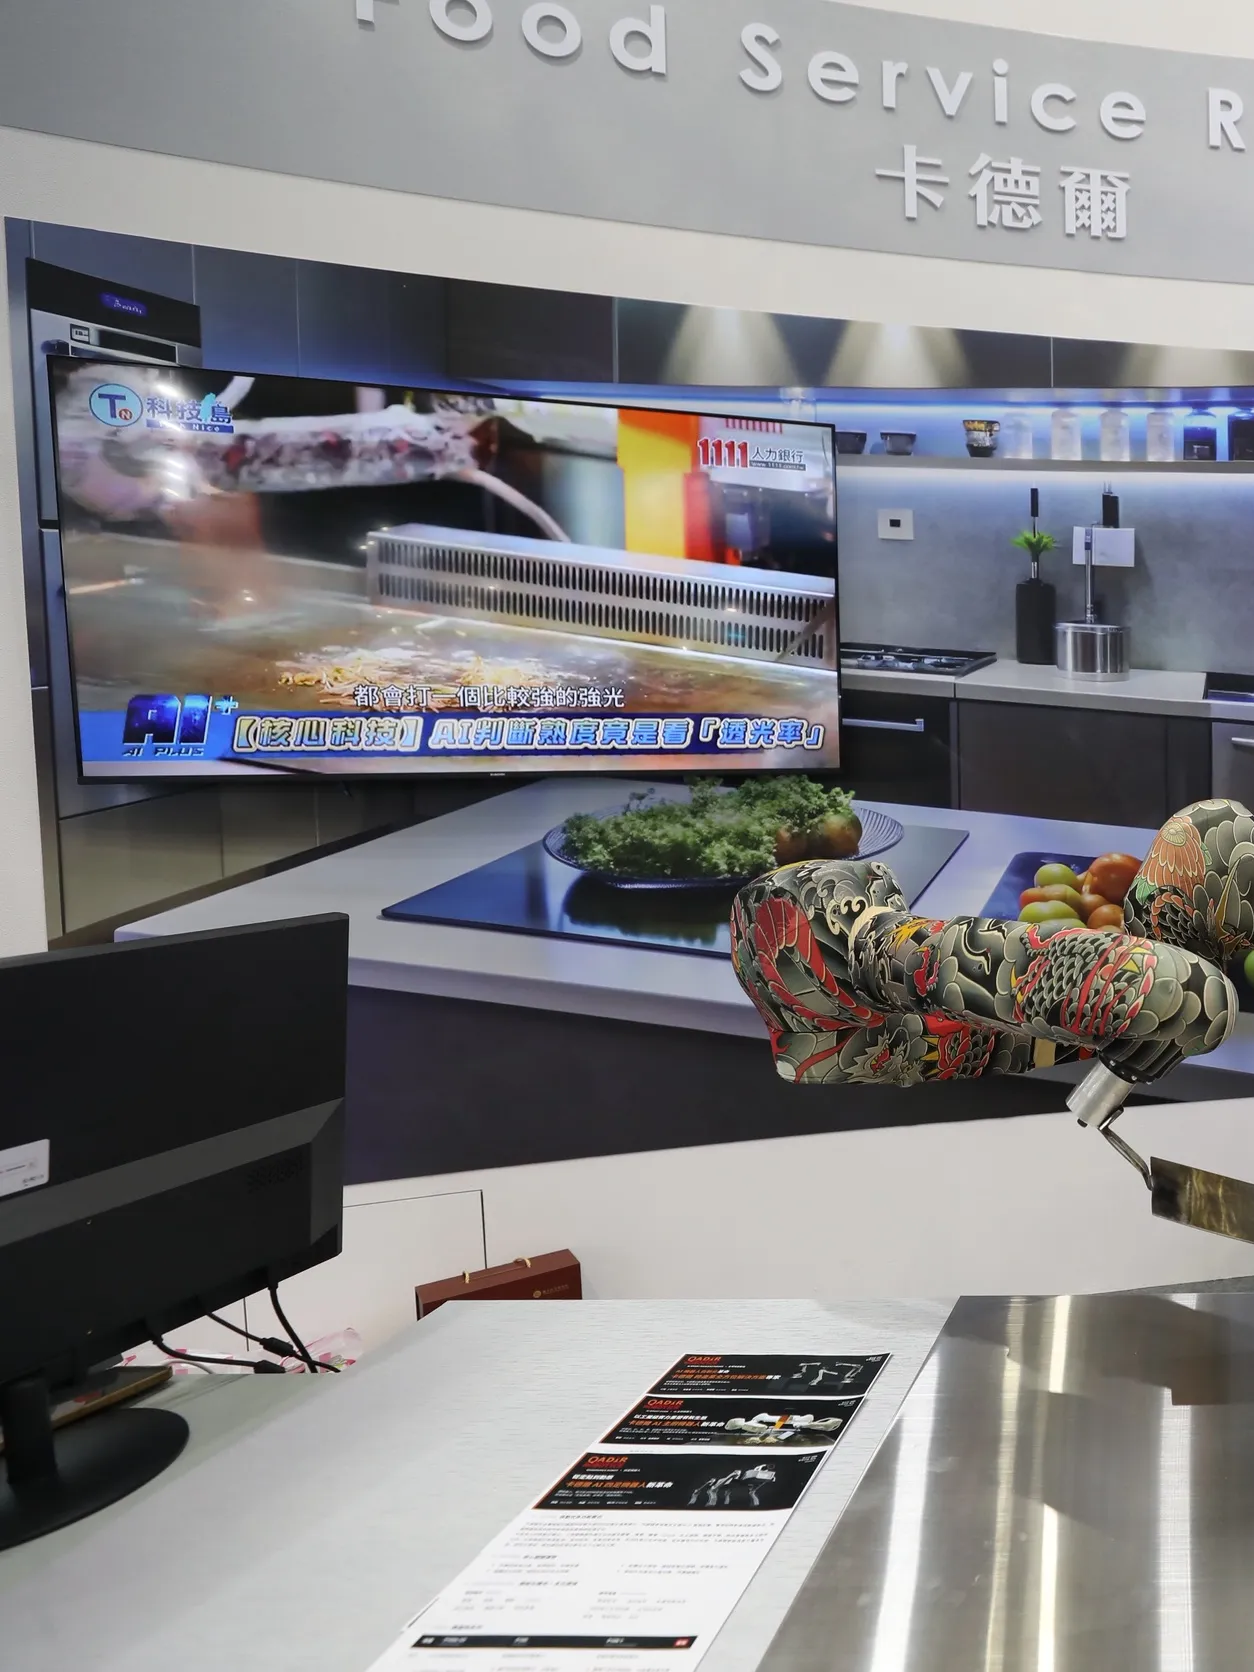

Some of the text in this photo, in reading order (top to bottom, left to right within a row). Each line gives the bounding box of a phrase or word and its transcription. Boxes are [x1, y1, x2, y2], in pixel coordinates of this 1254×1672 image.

[739, 22, 1147, 140] Service
[875, 144, 1131, 239] 卡德爾
[698, 438, 804, 468] 1111 人力銀行
[354, 685, 625, 709] 都會打一個比較強的強光
[154, 747, 205, 757] PLUS
